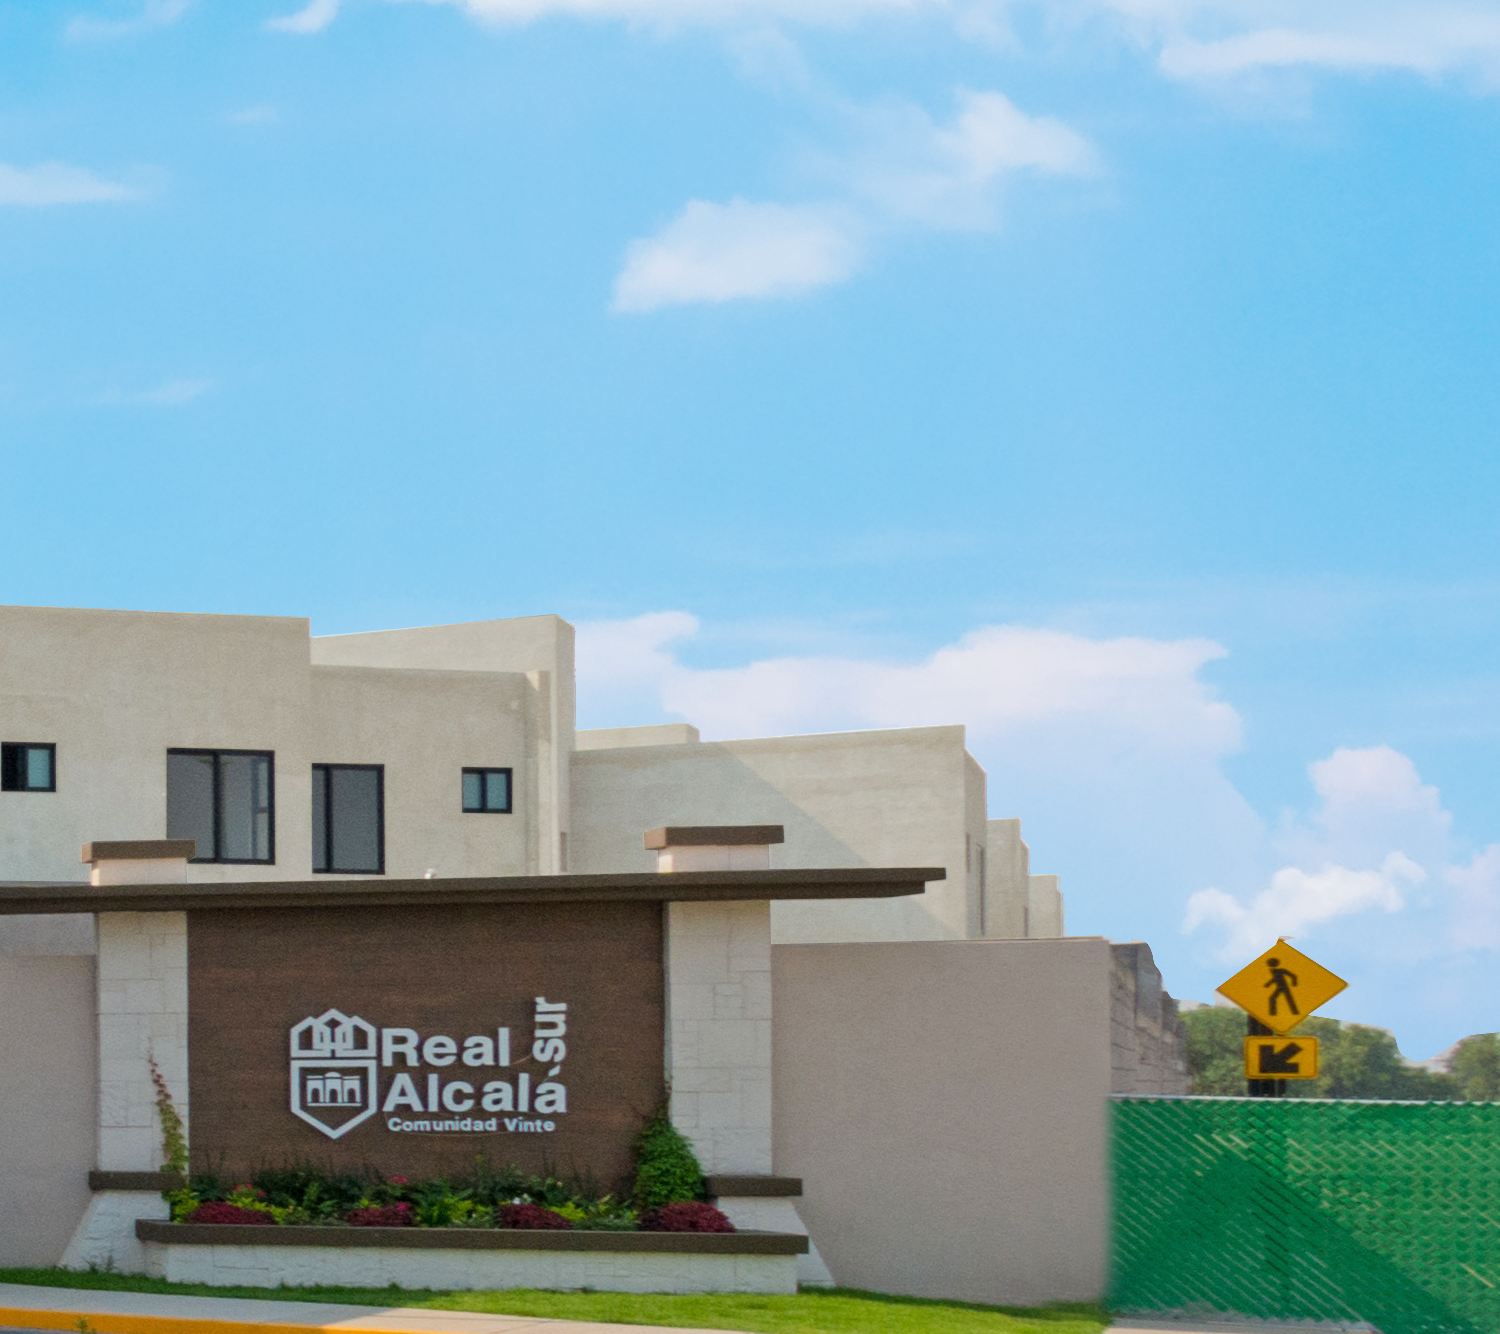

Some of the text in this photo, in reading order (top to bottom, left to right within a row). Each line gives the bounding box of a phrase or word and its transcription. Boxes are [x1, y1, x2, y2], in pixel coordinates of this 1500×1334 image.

[382, 1027, 510, 1066] Real
[532, 996, 567, 1062] sur
[382, 1064, 567, 1113] Alcalá
[387, 1116, 555, 1133] Comunidad Vinte
